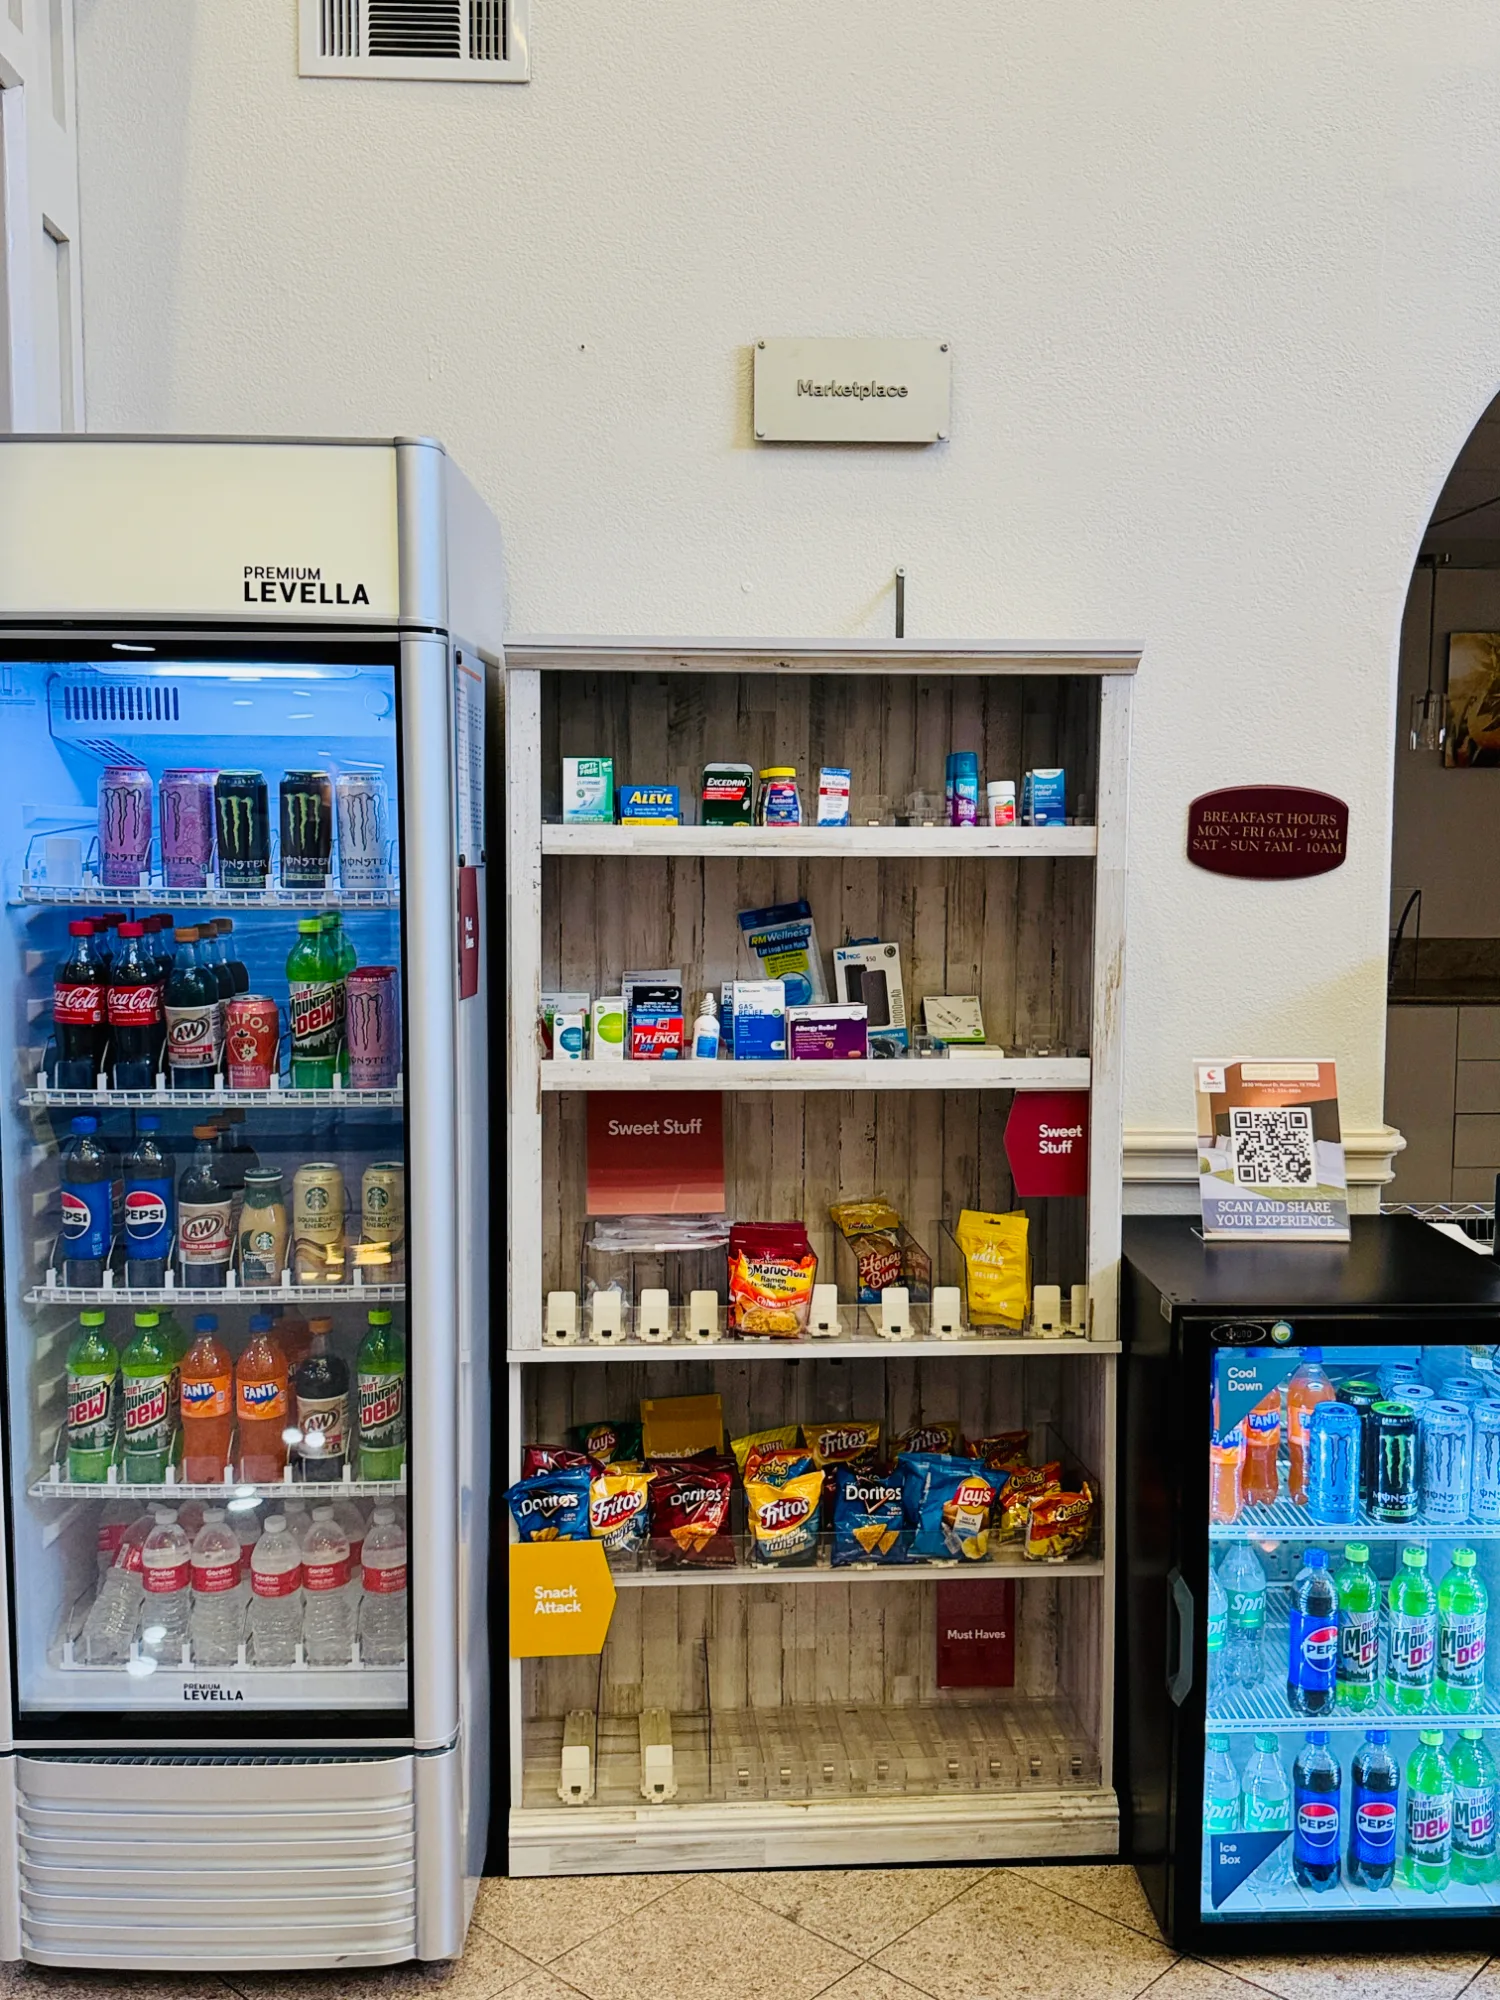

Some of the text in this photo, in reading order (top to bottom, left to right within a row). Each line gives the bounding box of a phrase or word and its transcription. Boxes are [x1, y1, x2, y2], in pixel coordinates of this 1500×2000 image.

[797, 379, 908, 401] Marketplace
[244, 566, 321, 580] PREMIUM
[244, 581, 370, 605] LEVELLA
[707, 777, 746, 787] EXCEDRIN
[629, 791, 673, 804] ALEVE
[1203, 811, 1337, 826] BREAKFAST HOURS
[1197, 825, 1231, 837] MON
[1242, 826, 1264, 838] FRI
[1268, 827, 1298, 838] 6AM
[1309, 828, 1340, 840] 9AM
[1192, 839, 1219, 850] SAT
[1230, 840, 1260, 851] SUN
[1265, 842, 1294, 853] 7AM
[1306, 842, 1342, 854] 10AM
[53, 985, 101, 1010] ca-Cola
[107, 985, 160, 1010] Coca-Cola
[295, 988, 313, 1001] DIET
[296, 1001, 335, 1035] DEW
[795, 1025, 817, 1033] Allergy
[633, 1032, 680, 1044] TYLENOL
[639, 1044, 655, 1052] PM
[350, 1056, 391, 1066] ONSTER
[608, 1118, 702, 1135] Sweet Stuff
[1038, 1123, 1083, 1138] Sweet
[1038, 1140, 1073, 1154] Stuff
[125, 1208, 165, 1220] PEPSI
[1217, 1201, 1332, 1213] SCAN AND SHARE
[62, 1210, 88, 1223] EPSI
[363, 1215, 400, 1223] OUBLESHOT
[1216, 1214, 1335, 1227] YOUR EXPERIENCE
[859, 1252, 901, 1275] Honey
[971, 1252, 1005, 1266] HALLS
[760, 1275, 787, 1285] Ramen
[866, 1268, 899, 1289] Bun
[1227, 1367, 1257, 1378] Cool
[126, 1384, 142, 1396] DIET
[182, 1382, 216, 1397] FANTA
[243, 1382, 279, 1400] FANTA
[361, 1380, 379, 1393] DIET
[1227, 1380, 1263, 1391] Down
[126, 1392, 165, 1428] DEW
[361, 1390, 400, 1425] DEW
[818, 1428, 866, 1457] Fritos
[650, 1450, 682, 1459] Snack
[757, 1461, 787, 1477] eetos
[1010, 1470, 1045, 1489] Cheetos
[670, 1488, 722, 1507] Doritos
[846, 1485, 902, 1501] Doritos
[958, 1486, 992, 1508] Lay's
[521, 1492, 579, 1516] Doritos
[591, 1490, 642, 1523] Fritos
[1055, 1501, 1090, 1521] Cheetos
[758, 1497, 811, 1528] Fritos
[765, 1530, 808, 1551] TWISTS
[533, 1584, 578, 1600] Snack
[534, 1599, 582, 1615] Attack
[1230, 1593, 1266, 1615] Spri
[947, 1629, 1006, 1640] Must Haves
[183, 1690, 244, 1701] LEVELLA
[1414, 1800, 1432, 1808] DIET
[1470, 1809, 1494, 1836] DE
[1219, 1842, 1237, 1852] Ice
[1219, 1854, 1241, 1864] Box
